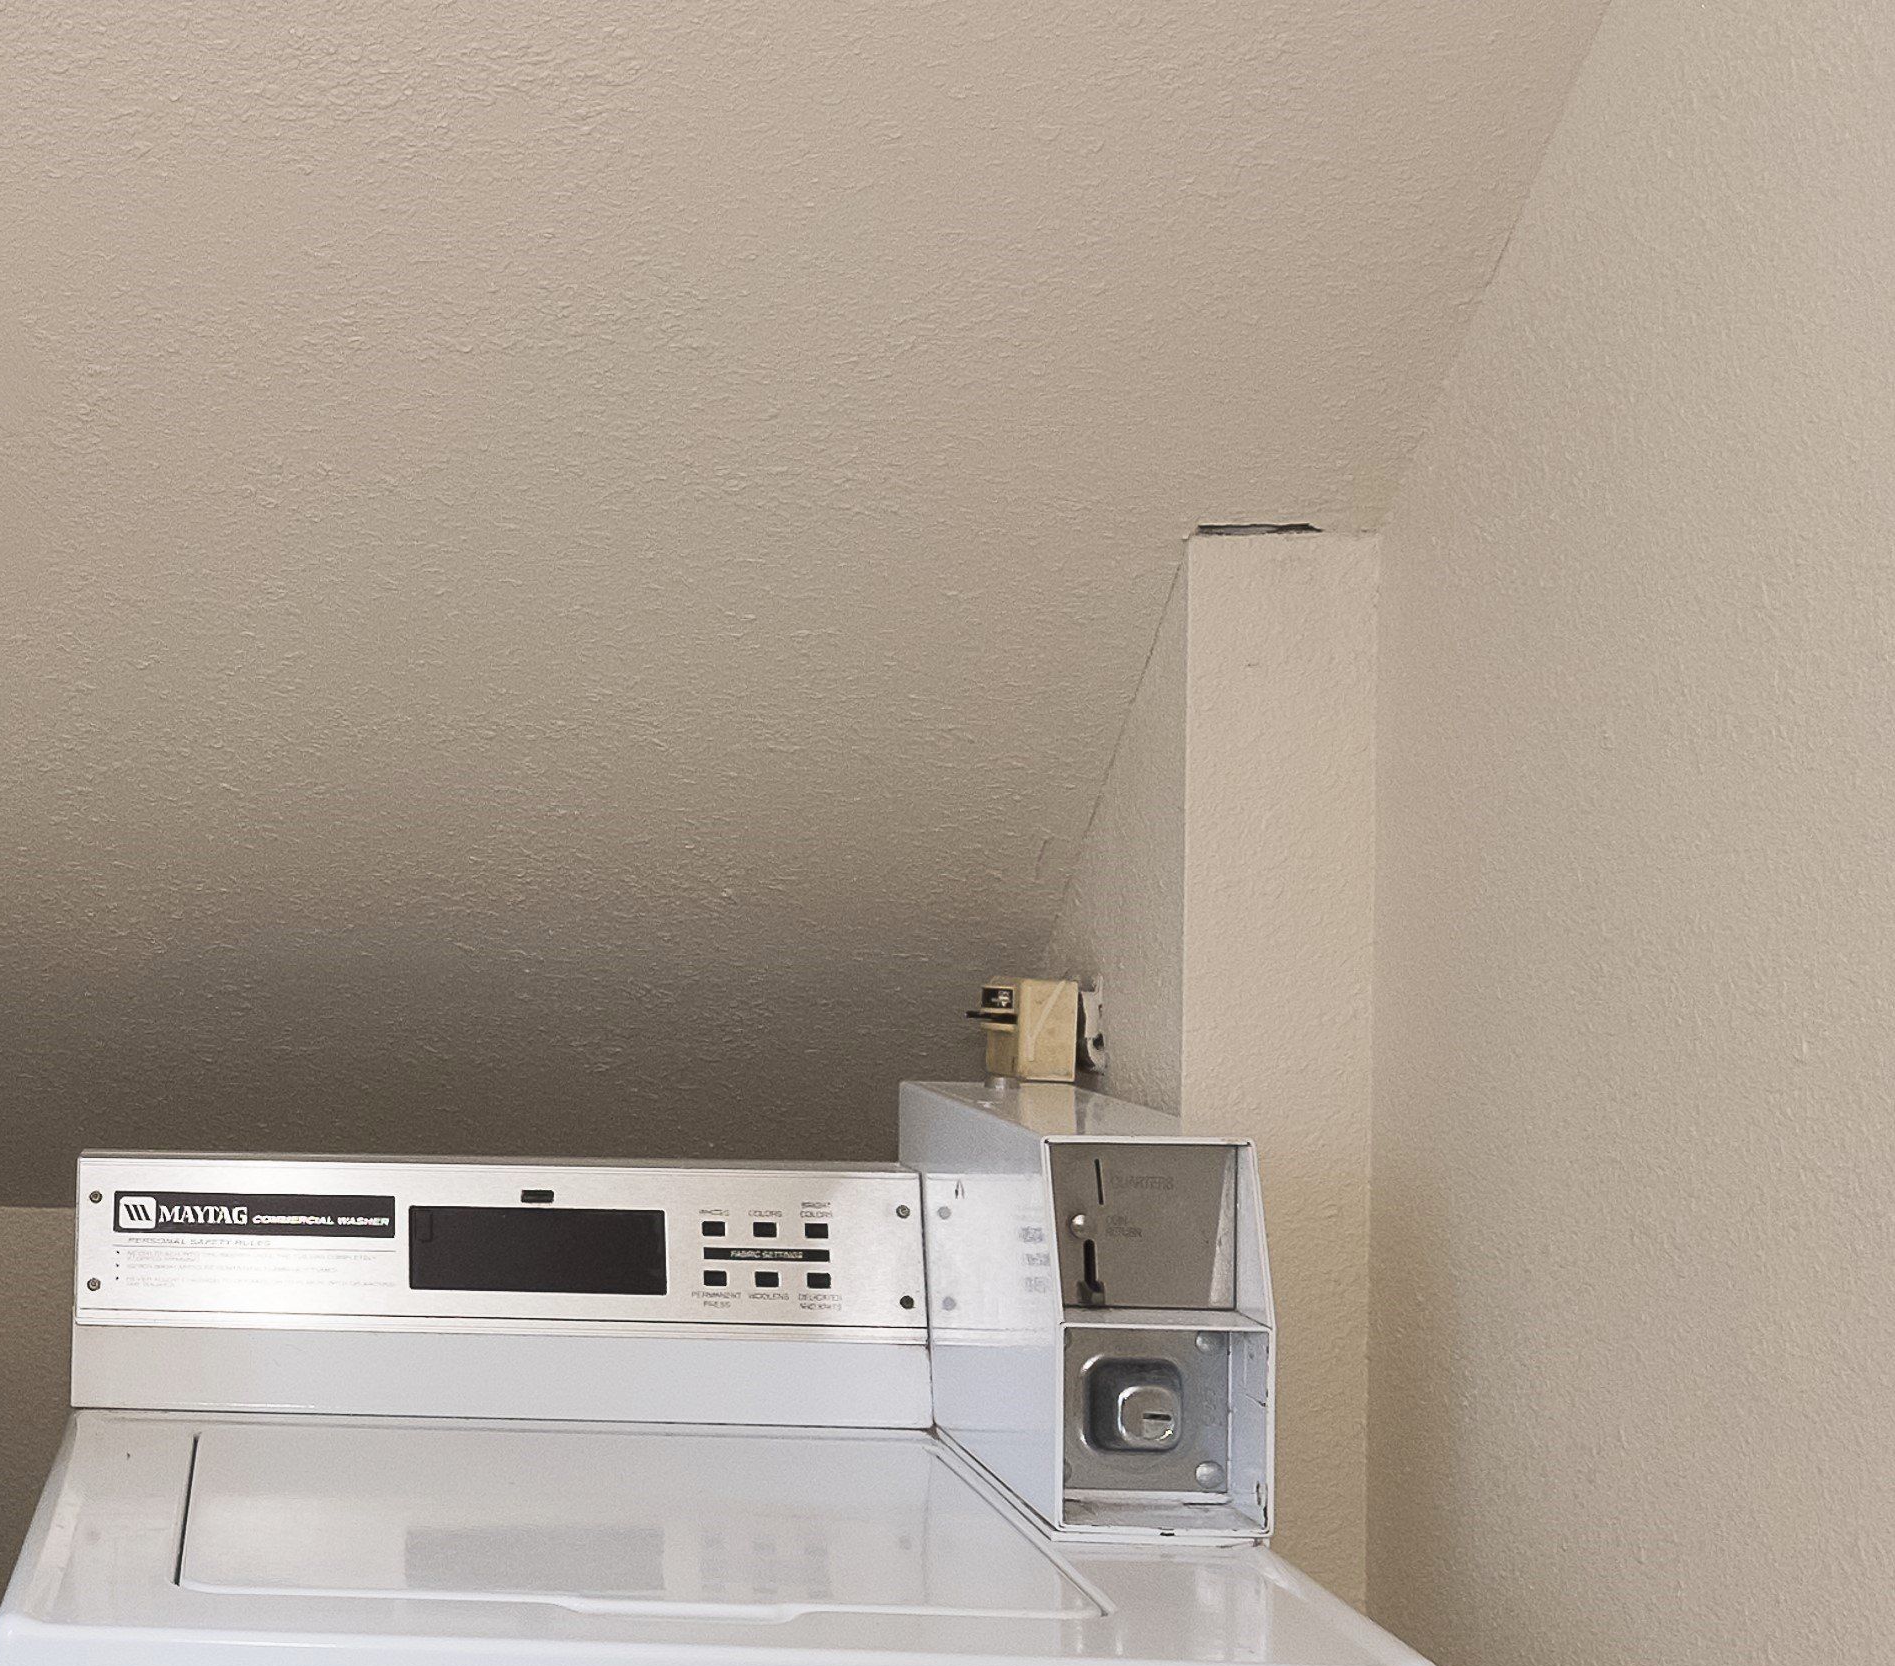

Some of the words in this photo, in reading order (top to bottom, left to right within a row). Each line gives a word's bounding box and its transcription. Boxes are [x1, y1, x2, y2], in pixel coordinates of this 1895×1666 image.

[158, 1204, 248, 1226] MAYTAG
[252, 1215, 335, 1226] COMMERCIAL
[337, 1216, 390, 1227] WASHER
